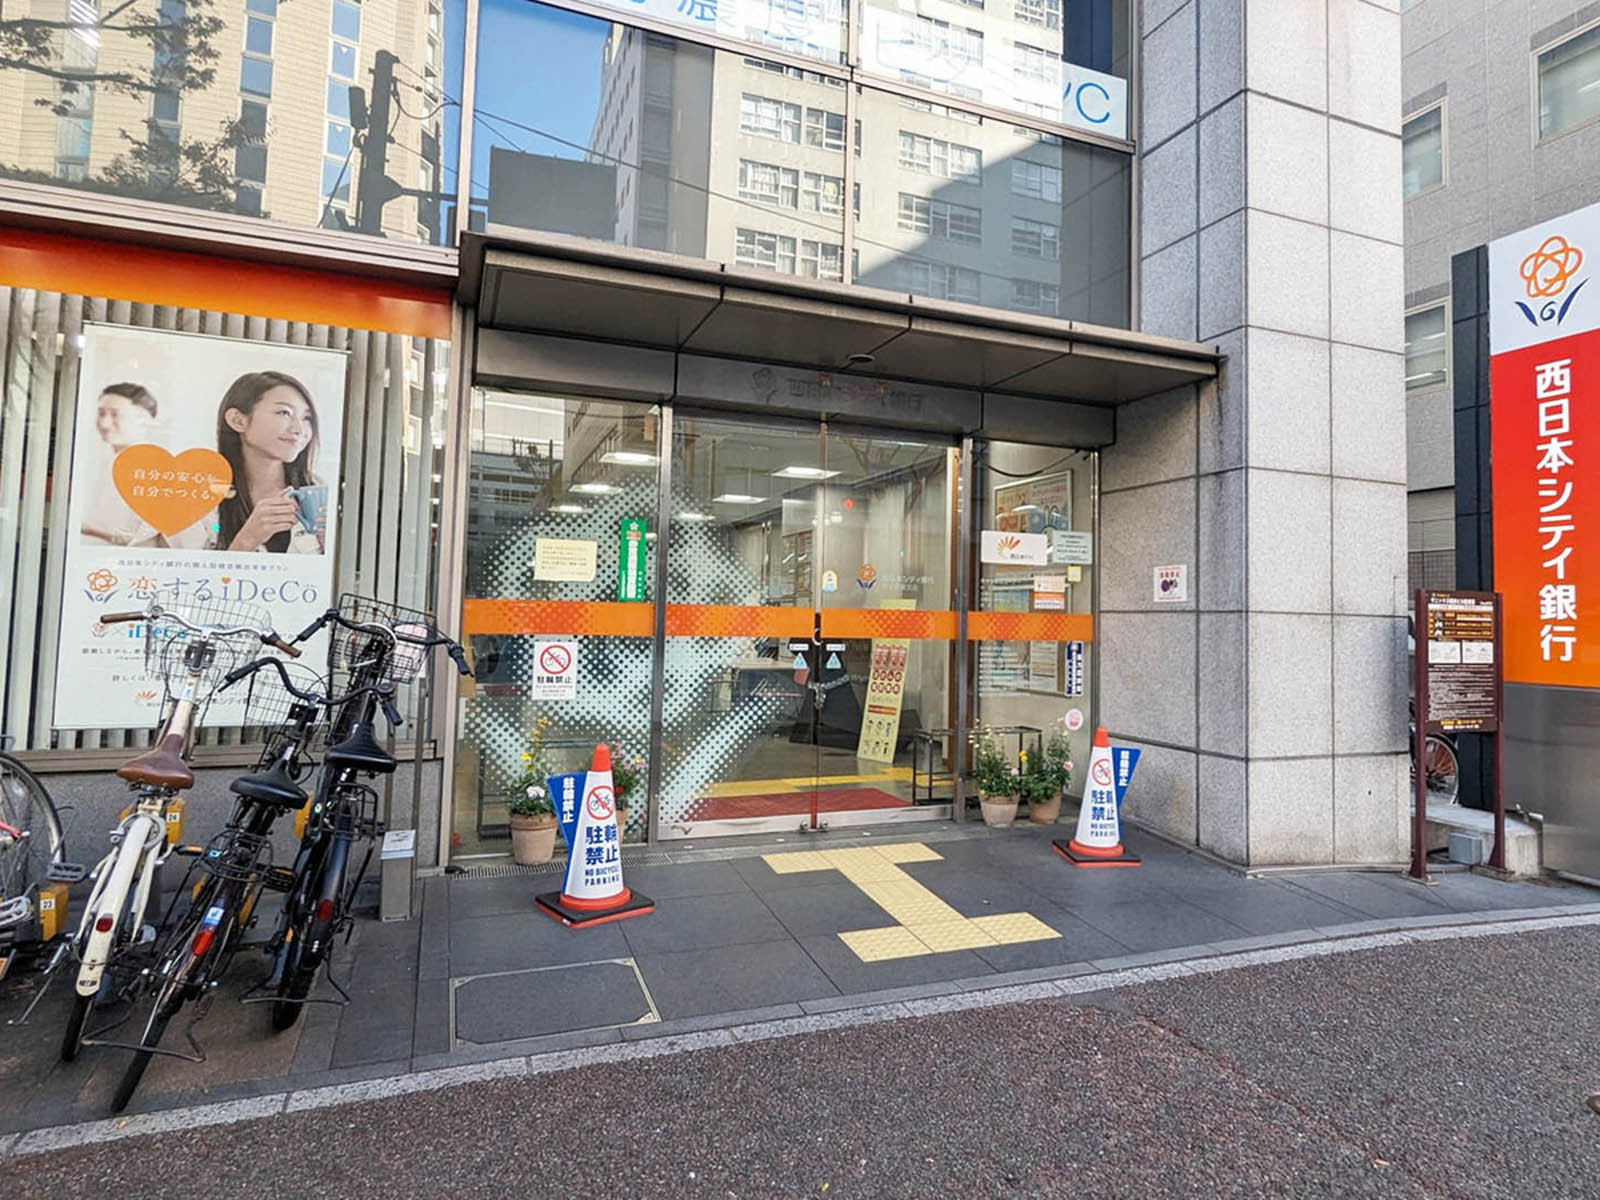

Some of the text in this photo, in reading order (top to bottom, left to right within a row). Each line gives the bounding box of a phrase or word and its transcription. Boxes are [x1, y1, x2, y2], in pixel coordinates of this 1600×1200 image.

[1534, 358, 1577, 662] 西日本シティ銀行
[585, 844, 620, 866] 禁止
